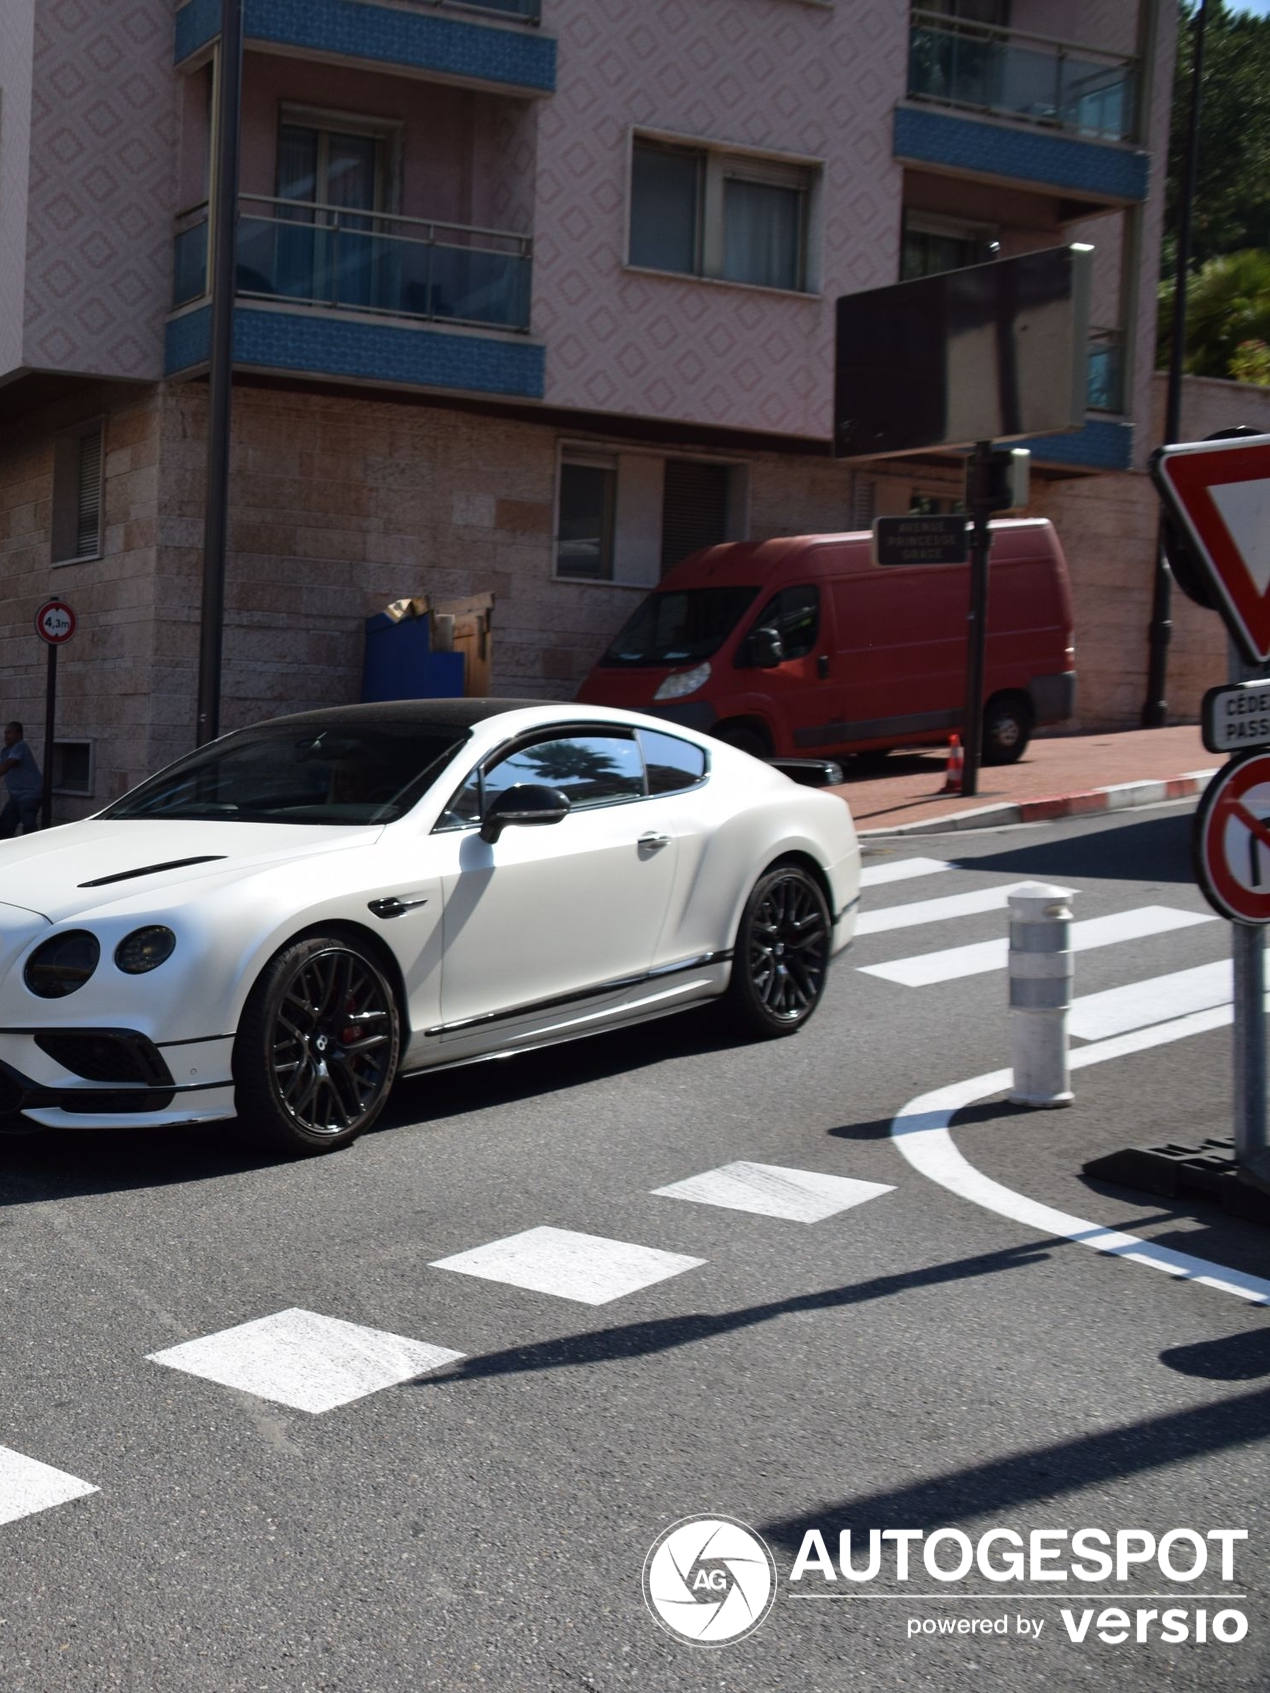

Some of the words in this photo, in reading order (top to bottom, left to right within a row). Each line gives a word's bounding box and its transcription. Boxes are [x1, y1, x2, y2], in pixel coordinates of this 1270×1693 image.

[899, 521, 946, 533] AVENUE
[886, 534, 957, 547] PRINCESSE
[901, 548, 944, 560] GRACE
